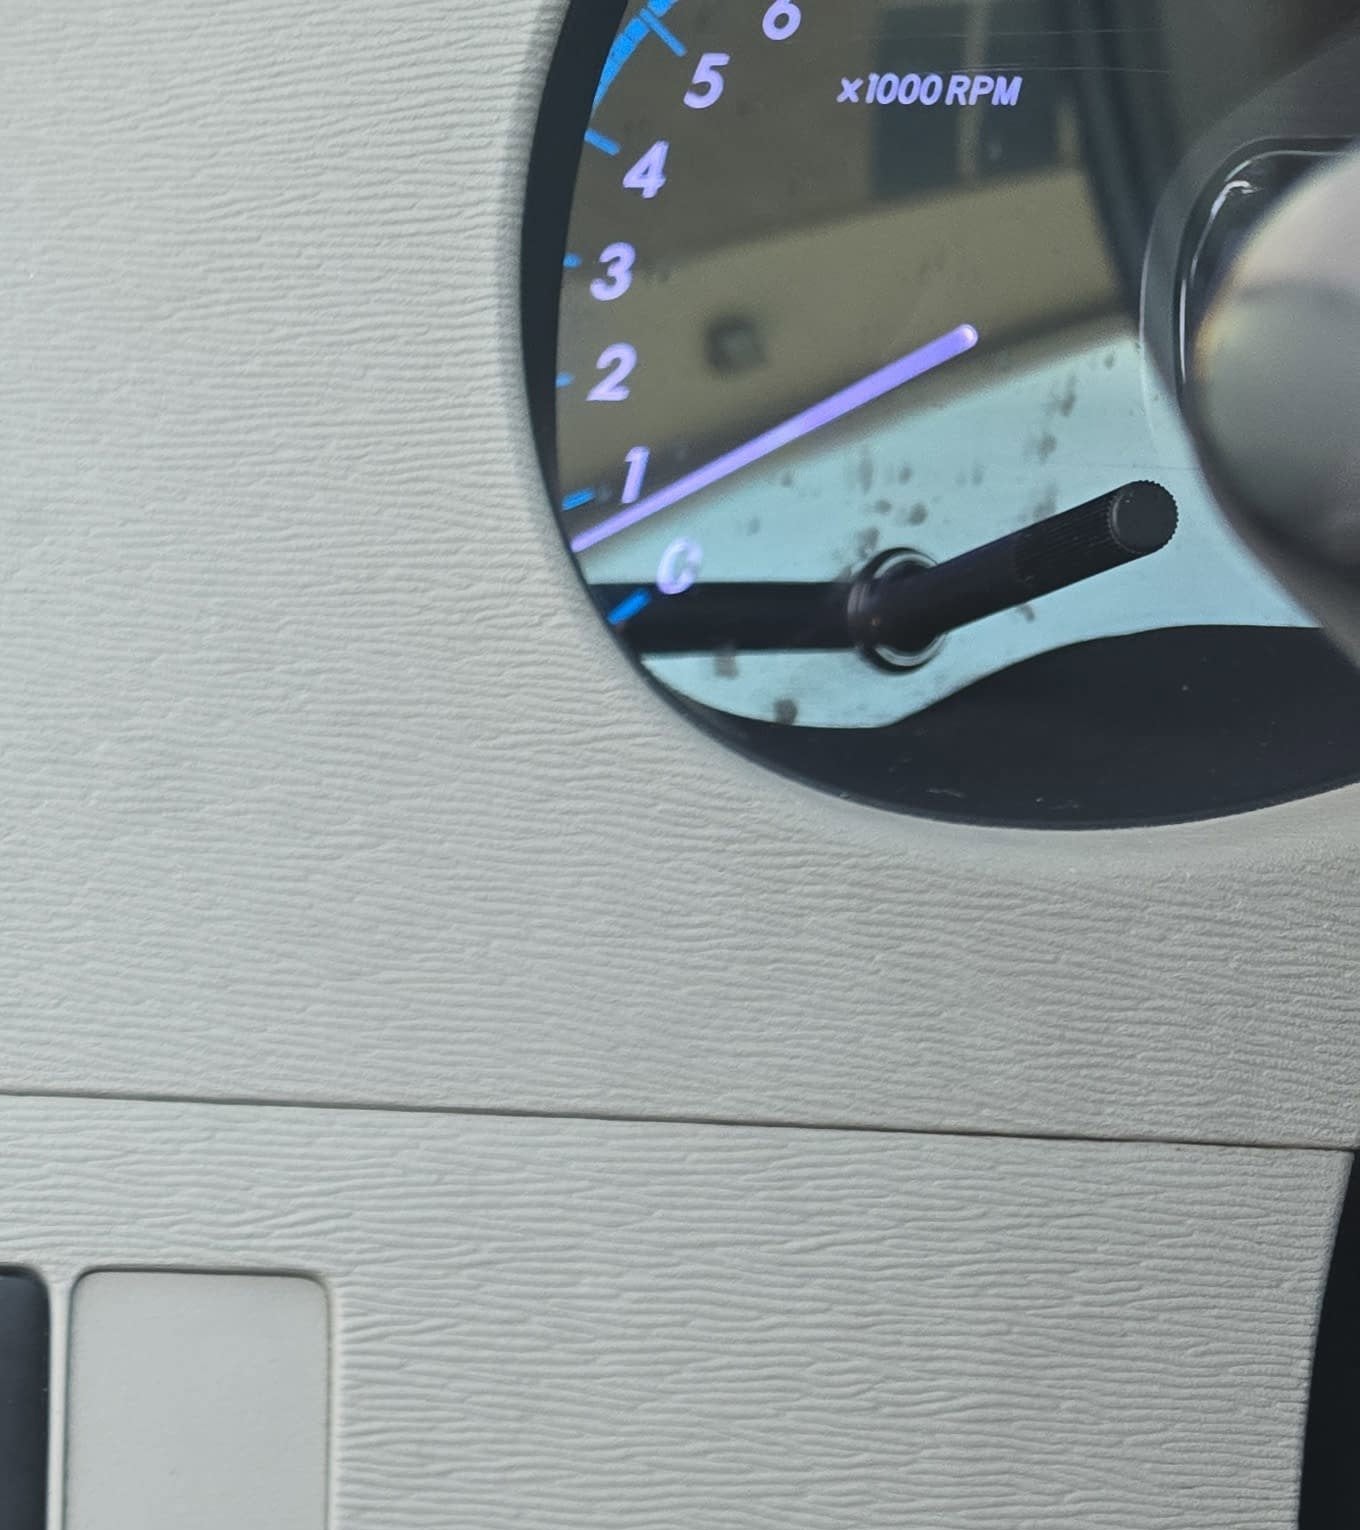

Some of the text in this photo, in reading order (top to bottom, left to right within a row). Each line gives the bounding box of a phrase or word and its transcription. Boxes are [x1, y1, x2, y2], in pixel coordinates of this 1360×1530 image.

[763, 0, 802, 41] 6
[683, 53, 729, 109] 5
[944, 75, 1023, 106] RPM
[623, 140, 668, 199] 4
[590, 242, 636, 302] 3
[586, 343, 637, 401] 2
[621, 446, 651, 505] 1
